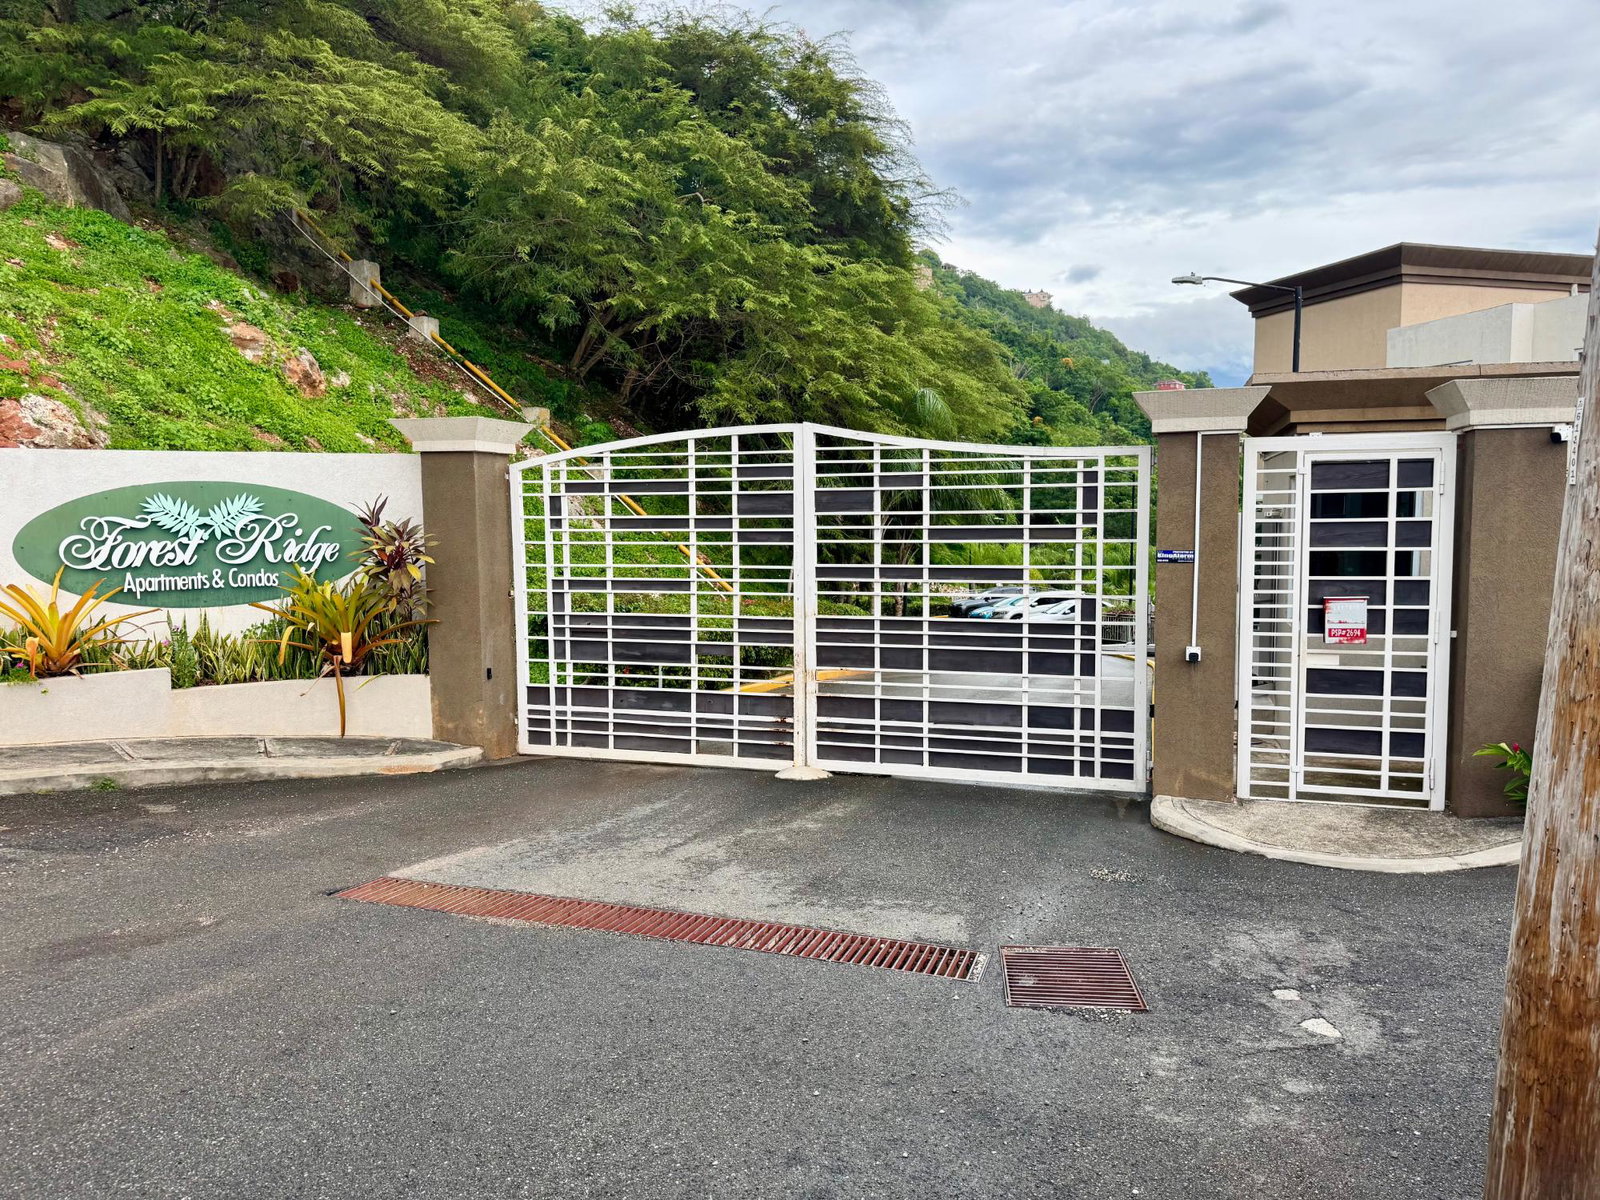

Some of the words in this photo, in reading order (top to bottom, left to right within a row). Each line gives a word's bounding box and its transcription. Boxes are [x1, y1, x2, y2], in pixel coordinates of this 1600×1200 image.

[58, 515, 207, 571] Forest
[215, 513, 340, 574] Ridge
[123, 571, 210, 600] Apartments
[211, 568, 225, 589] &
[228, 567, 280, 588] Condos
